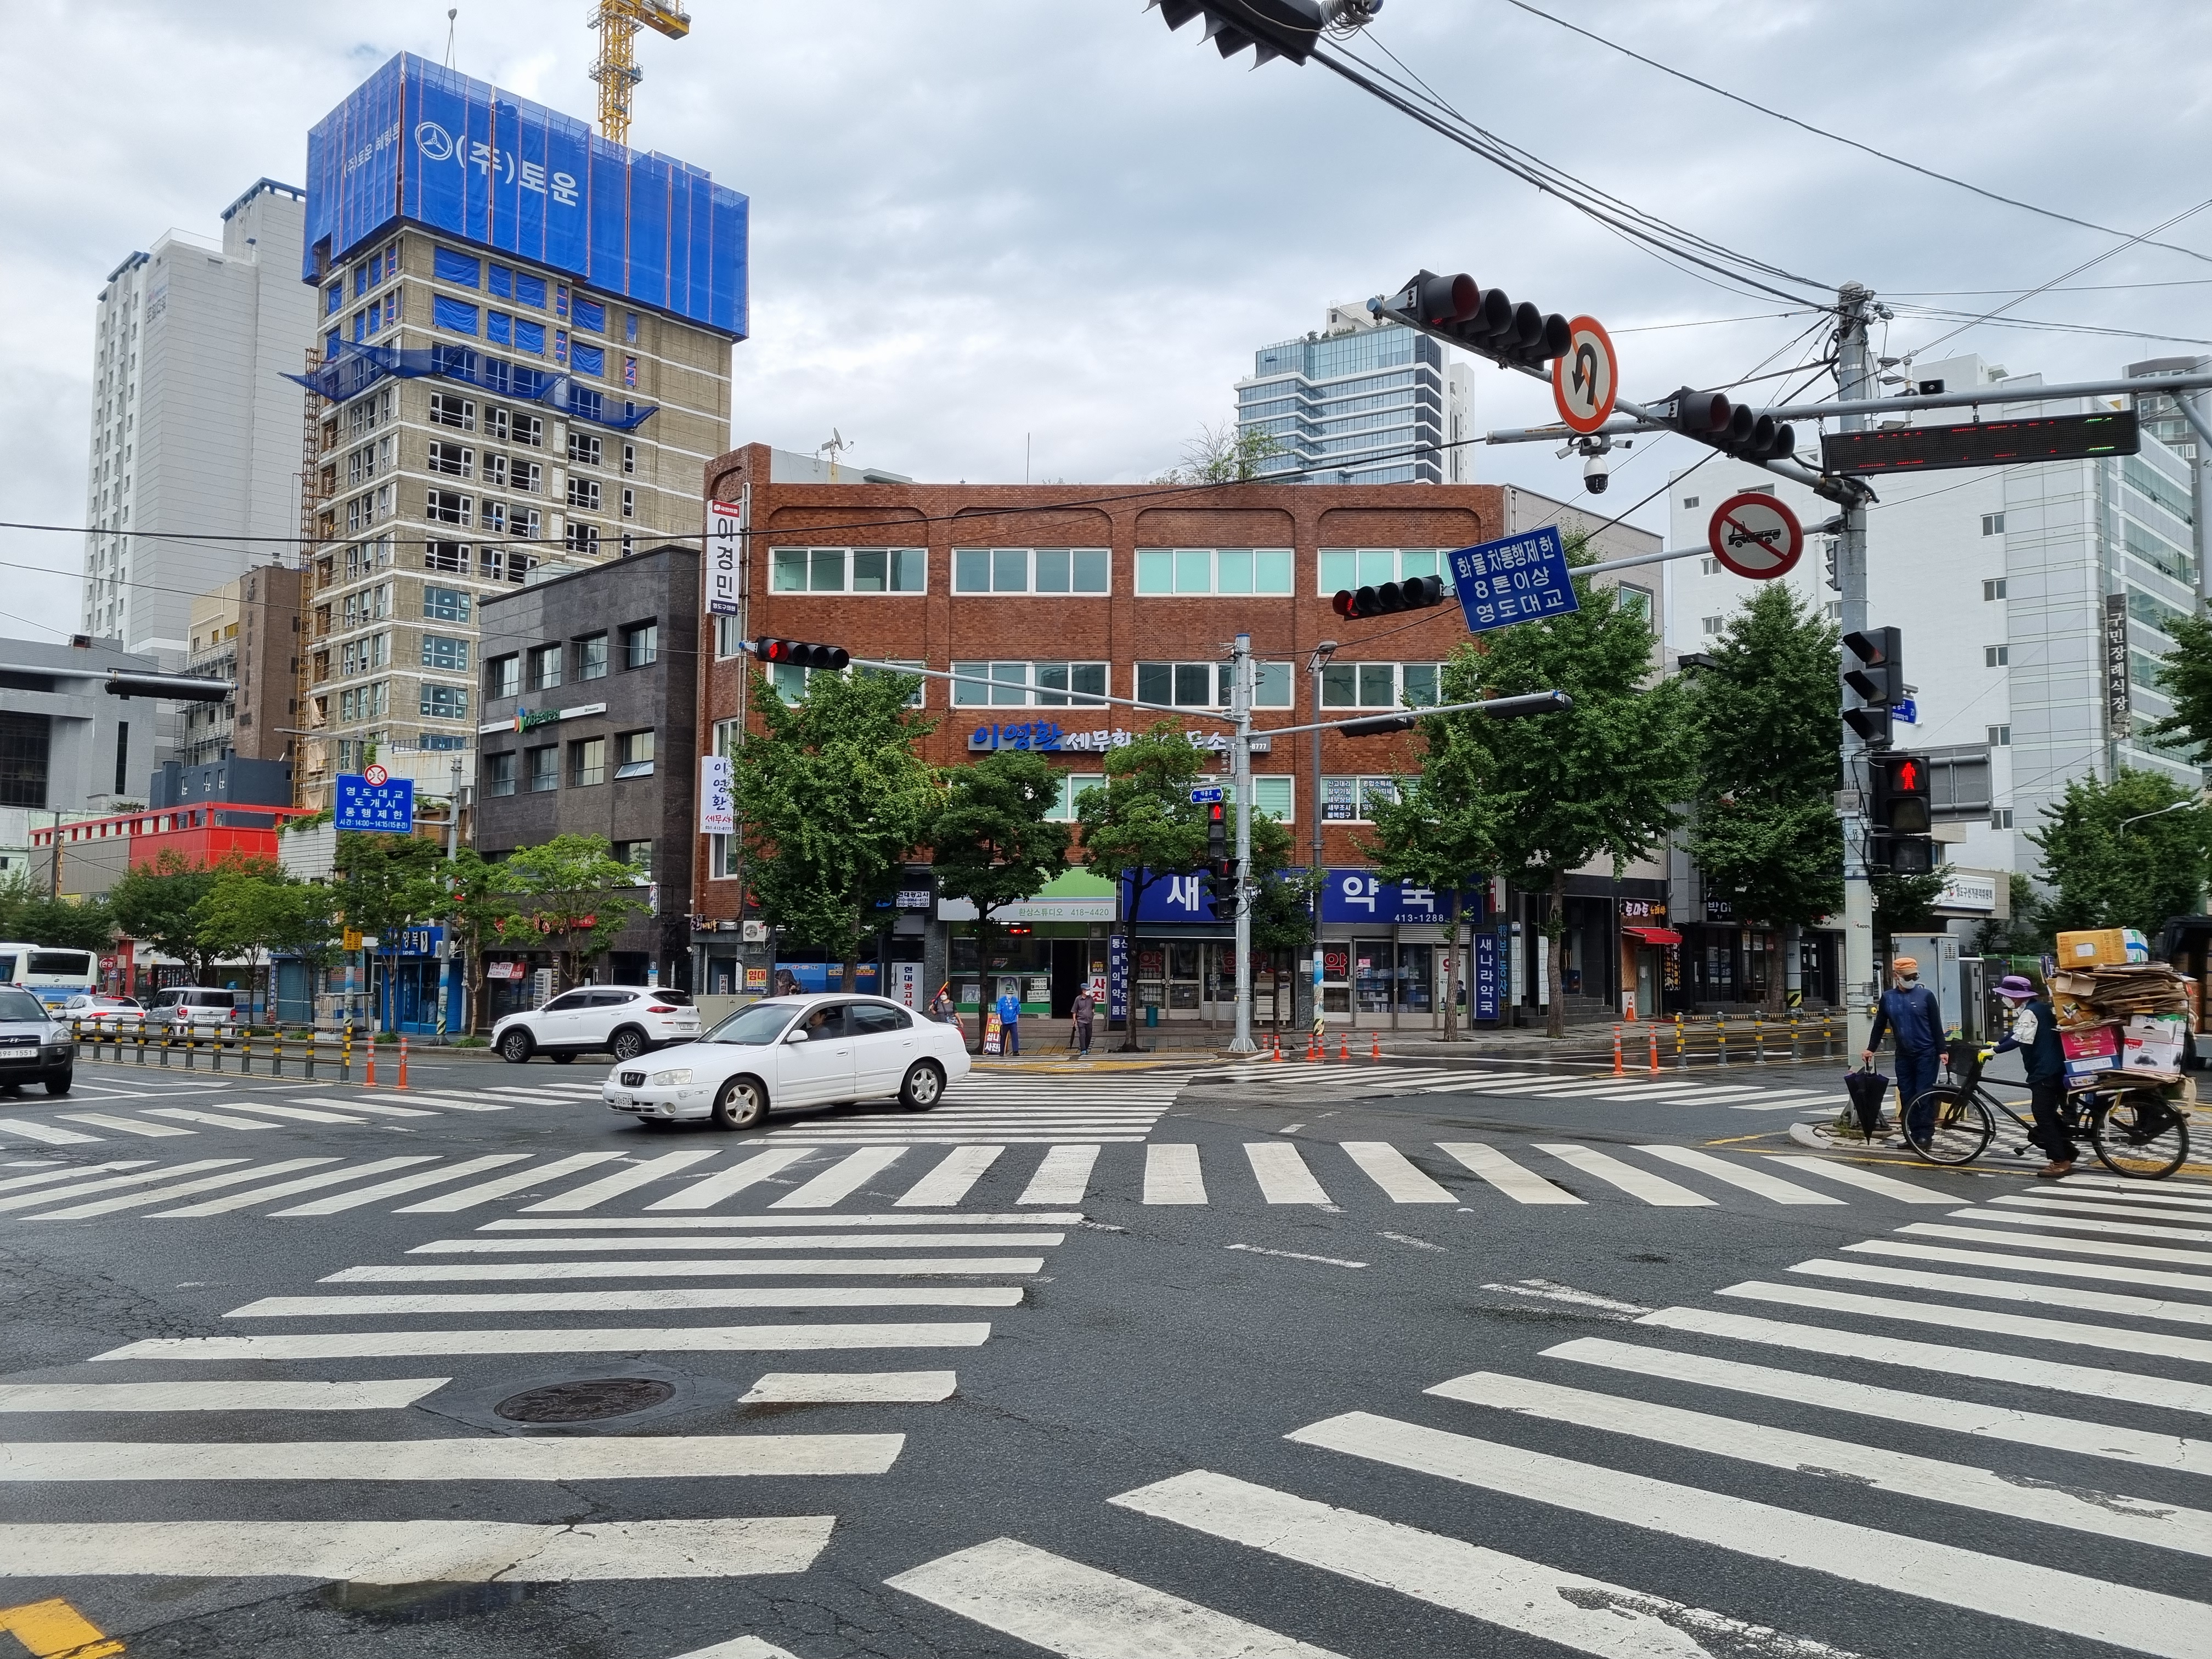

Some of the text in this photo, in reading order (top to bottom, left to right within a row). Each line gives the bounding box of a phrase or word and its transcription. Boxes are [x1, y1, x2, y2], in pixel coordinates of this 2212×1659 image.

[456, 135, 578, 207] (주)토운
[717, 518, 733, 599] 이경민
[713, 603, 736, 612] 영도구의원
[1476, 589, 1564, 623] 영도대교
[2109, 612, 2129, 710] 구민장례식장
[974, 719, 1064, 751] 이영환
[346, 787, 404, 799] 영도대교
[713, 762, 726, 811] 이영환
[345, 807, 403, 820] 통행제한
[354, 798, 396, 809] 도개시
[1019, 908, 1063, 917] 환상스튜디오
[1394, 914, 1444, 922] 413-1288
[1626, 901, 1649, 917] 토마토
[403, 931, 419, 949] 양복
[1139, 951, 1163, 974] 약
[1324, 953, 1347, 976] 약
[1498, 940, 1508, 997] 부동산
[748, 970, 765, 980] 임대
[904, 966, 913, 1007] 현대광고사
[1112, 939, 1121, 1015] 동물의약품
[1480, 939, 1493, 1013] 새나라약국
[1092, 978, 1106, 1002] 사진
